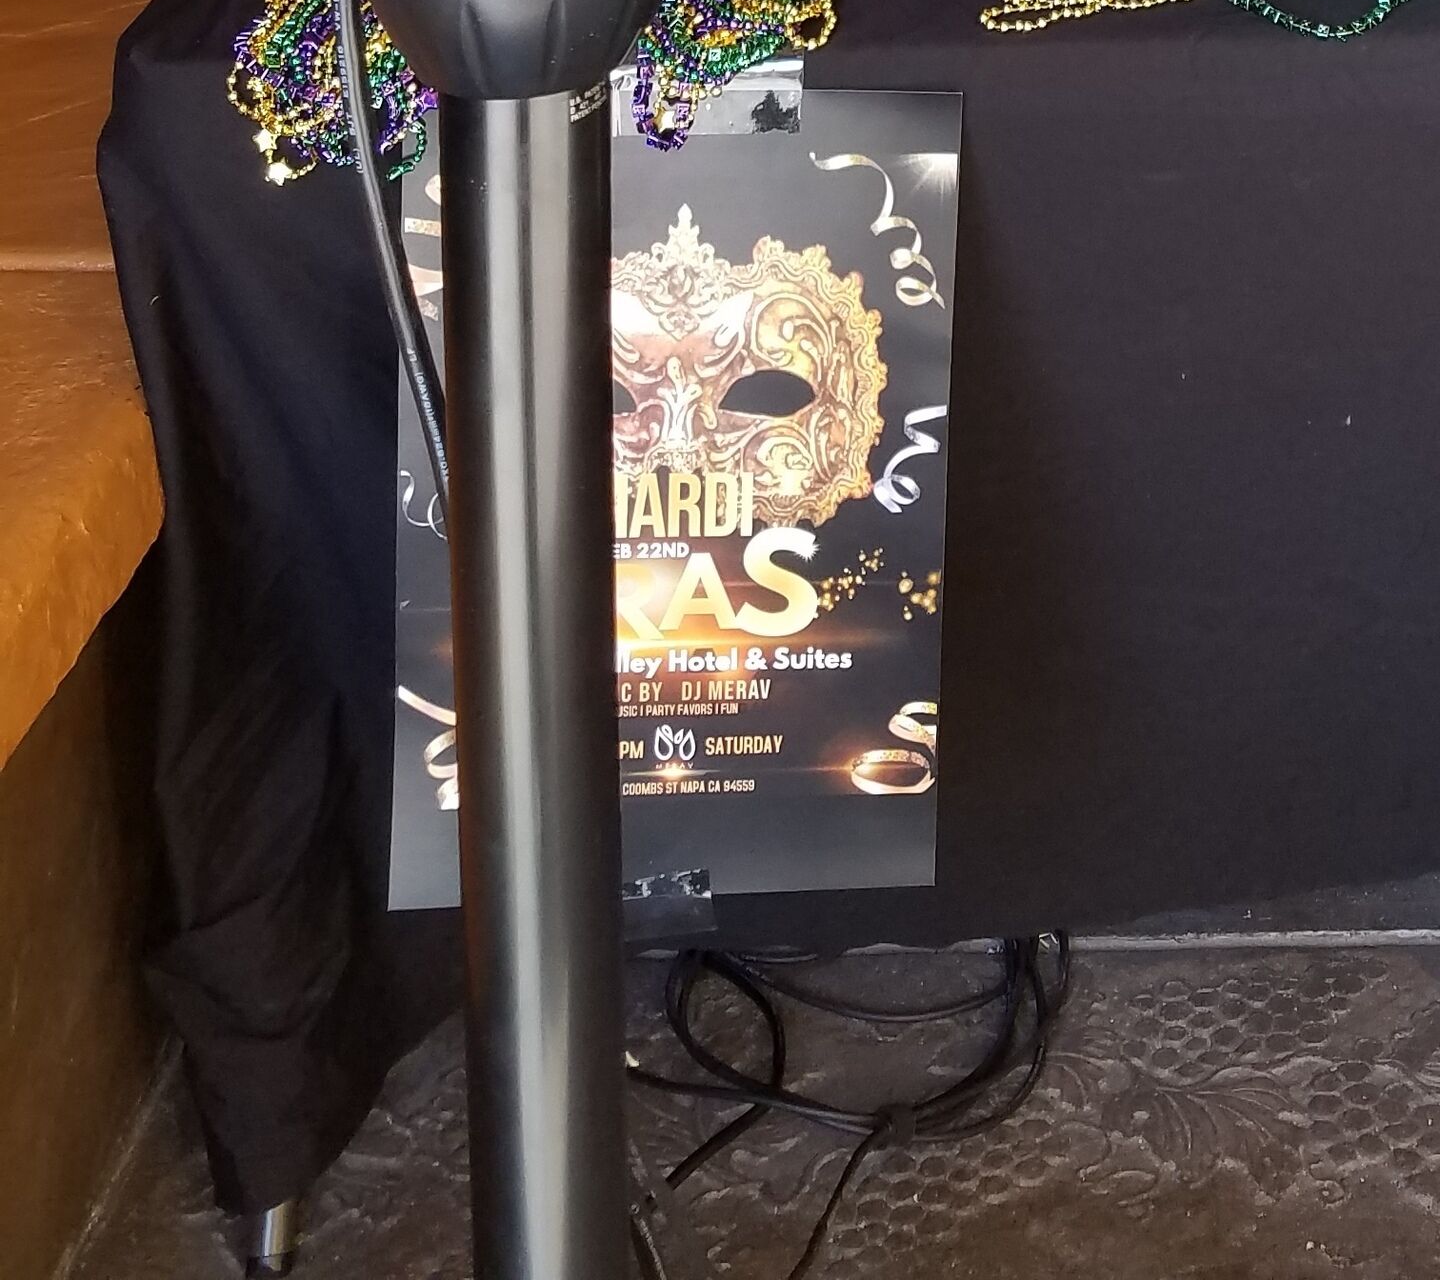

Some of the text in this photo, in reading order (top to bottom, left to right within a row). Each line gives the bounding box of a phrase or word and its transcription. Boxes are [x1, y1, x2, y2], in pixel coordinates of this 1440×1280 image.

[615, 471, 754, 539] ARDI
[613, 541, 690, 559] EB 22ND
[615, 526, 820, 640] RAS
[668, 646, 739, 673] Hotel
[744, 646, 769, 671] &
[772, 645, 853, 671] Suites
[639, 681, 663, 703] BY
[681, 679, 702, 702] DJ
[708, 677, 772, 701] MERAV
[645, 704, 676, 717] PARTY
[676, 703, 713, 716] FAVORS
[720, 702, 739, 715] FUN
[619, 734, 784, 760] PM SATURDAY
[622, 778, 756, 797] COOMBS ST NAPA CA 94559
